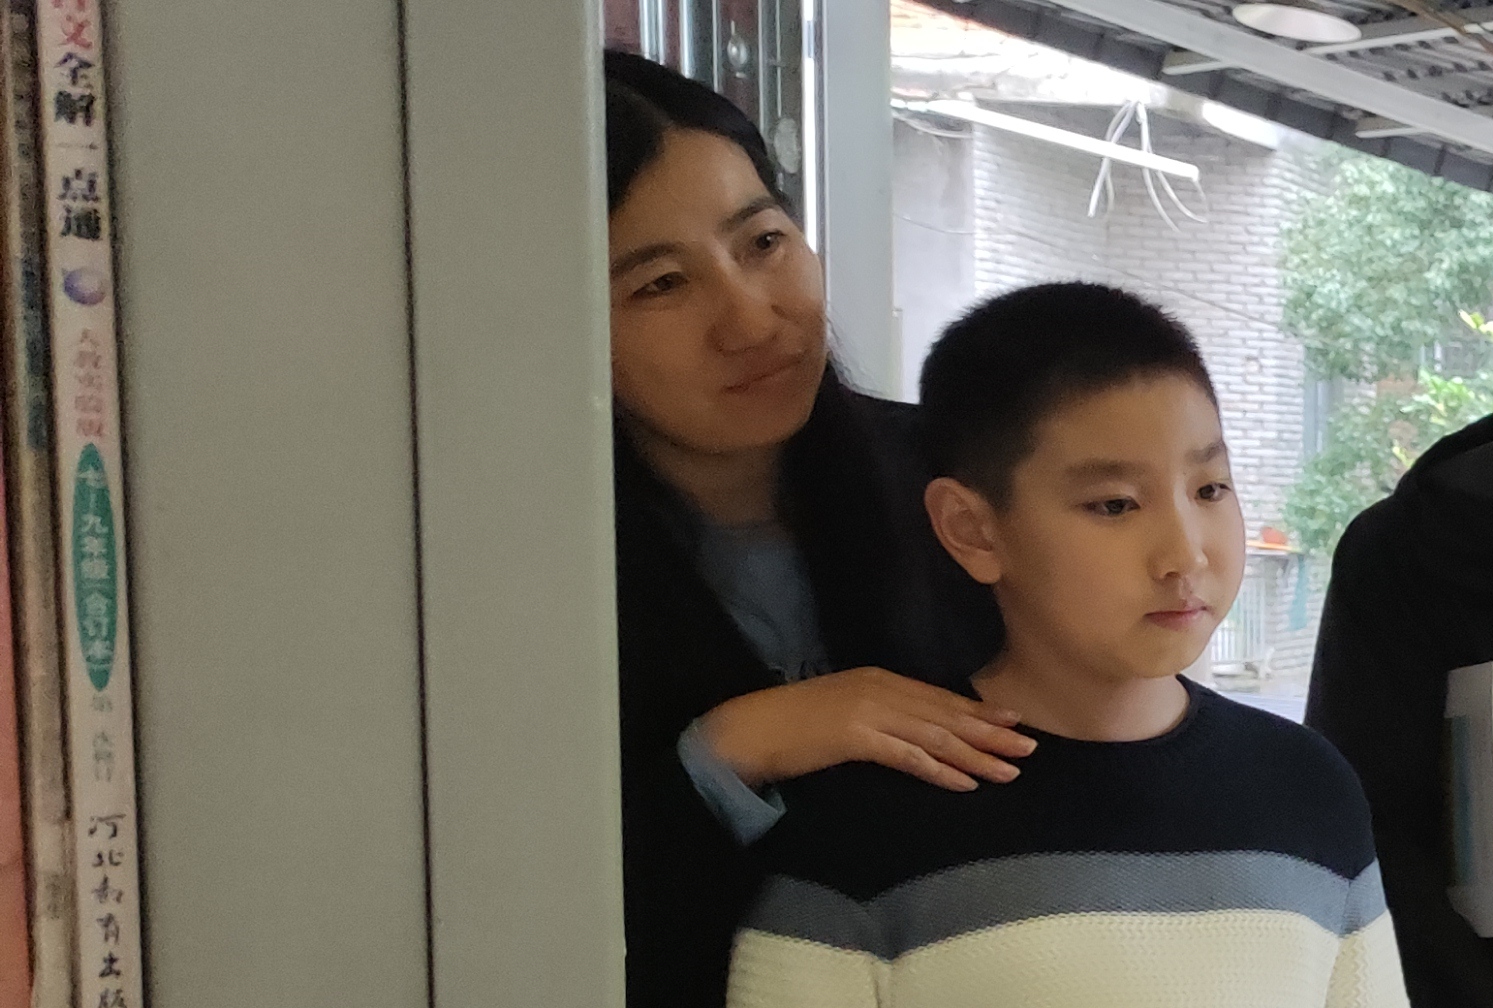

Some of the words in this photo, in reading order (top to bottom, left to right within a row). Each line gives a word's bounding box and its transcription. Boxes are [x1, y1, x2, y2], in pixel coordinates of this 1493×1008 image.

[53, 0, 103, 241] 文全解一点通
